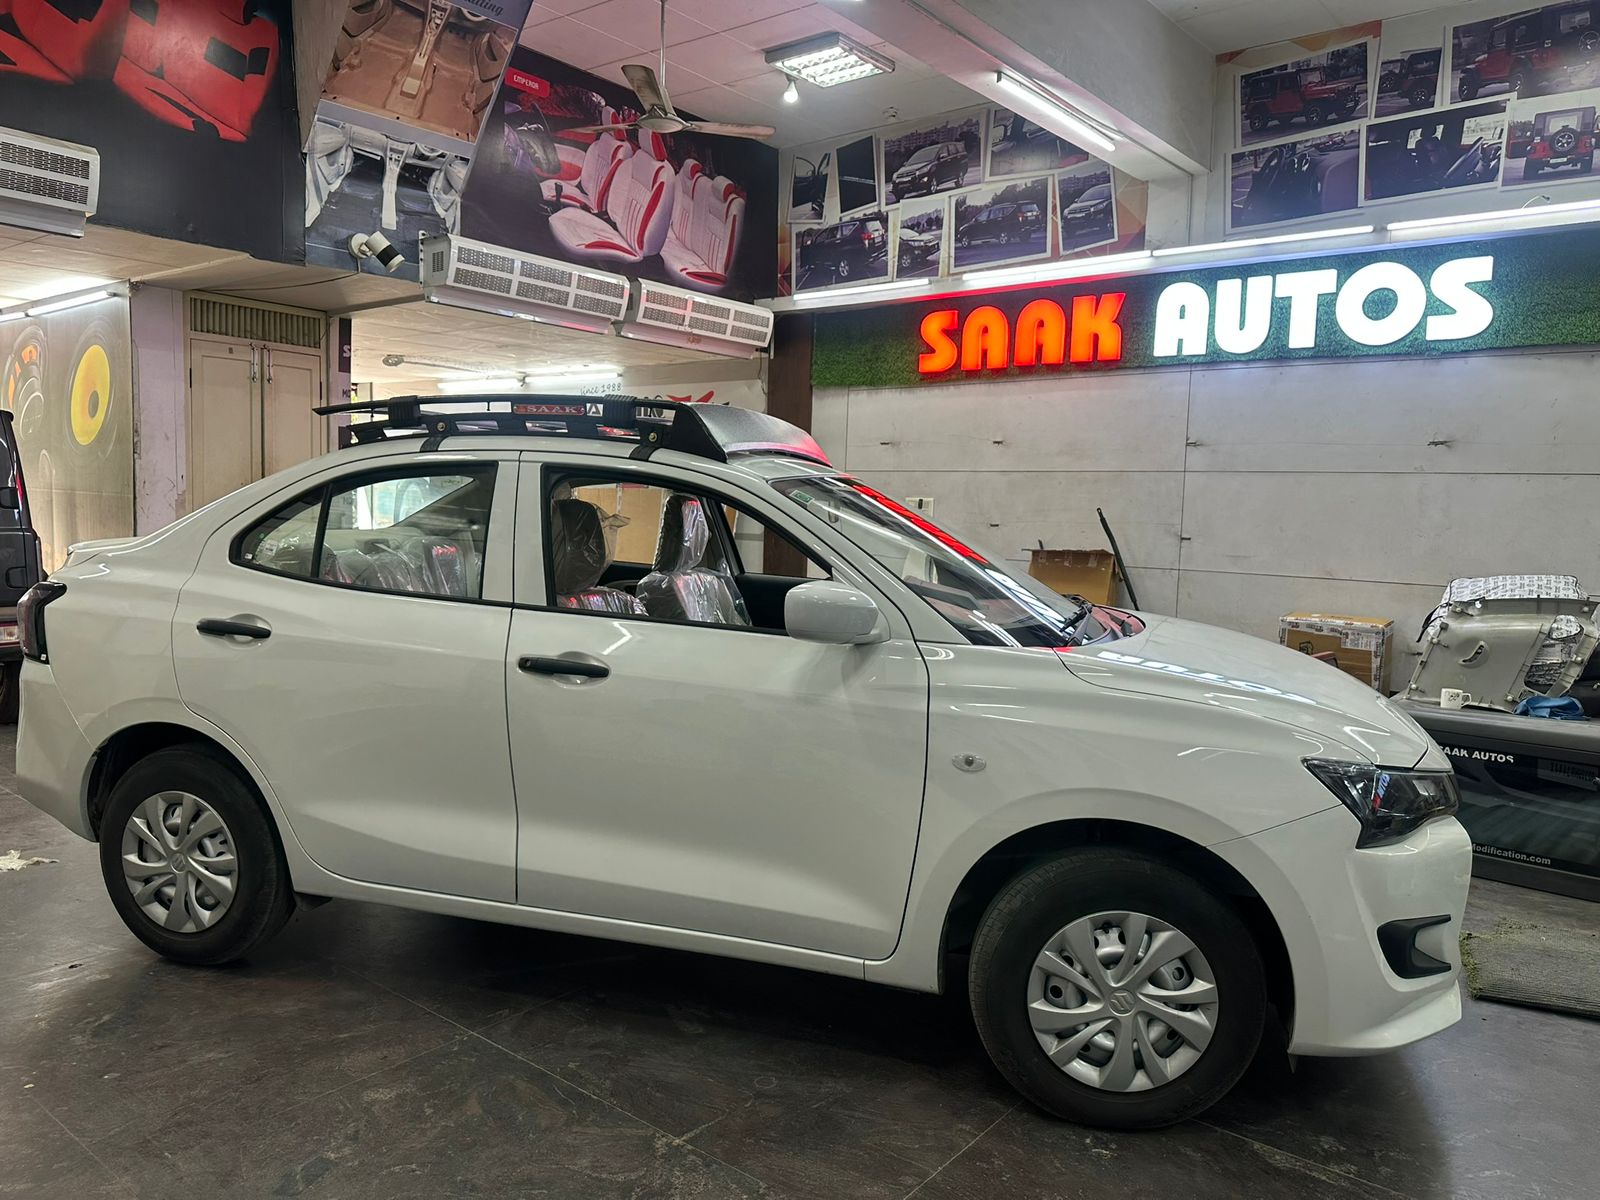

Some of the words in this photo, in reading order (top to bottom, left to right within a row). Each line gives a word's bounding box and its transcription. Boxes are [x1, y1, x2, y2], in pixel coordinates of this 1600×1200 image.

[513, 74, 539, 90] EMPEROR
[918, 292, 1127, 374] SAAK
[1153, 255, 1495, 357] AUTOS
[601, 382, 622, 393] 1988
[526, 405, 578, 414] SAAK
[1472, 750, 1514, 763] AUTOS
